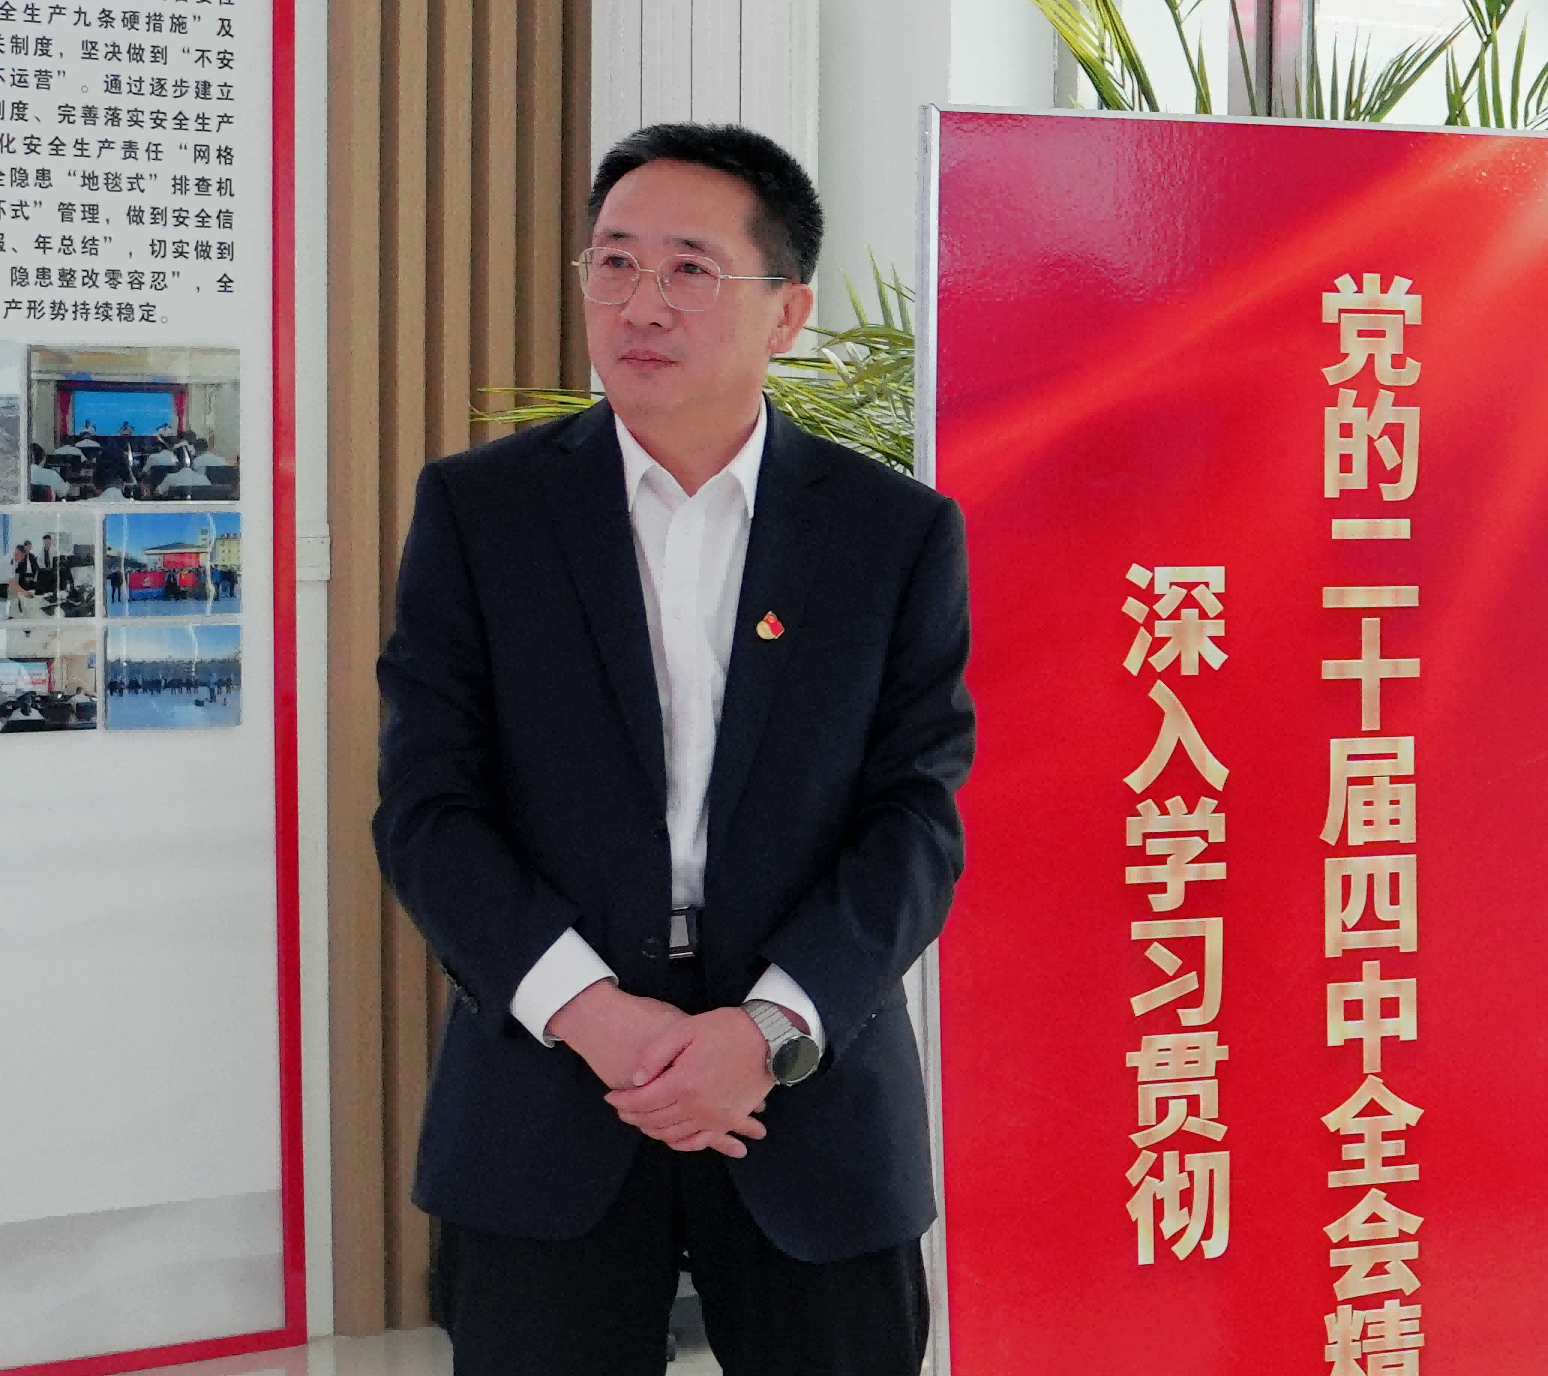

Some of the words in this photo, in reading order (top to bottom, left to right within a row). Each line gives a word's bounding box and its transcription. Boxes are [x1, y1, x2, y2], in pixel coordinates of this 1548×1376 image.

[0, 34, 235, 71] 制度，坚决做到“不安
[0, 67, 235, 102] 运营”。通过逐步建立
[0, 99, 235, 134] 度、完善落实安全生产
[0, 166, 235, 198] 隐患“地毯式”排查机
[3, 298, 169, 325] 产形势持续稳定。
[1122, 561, 1233, 1267] 深入学习贯彻
